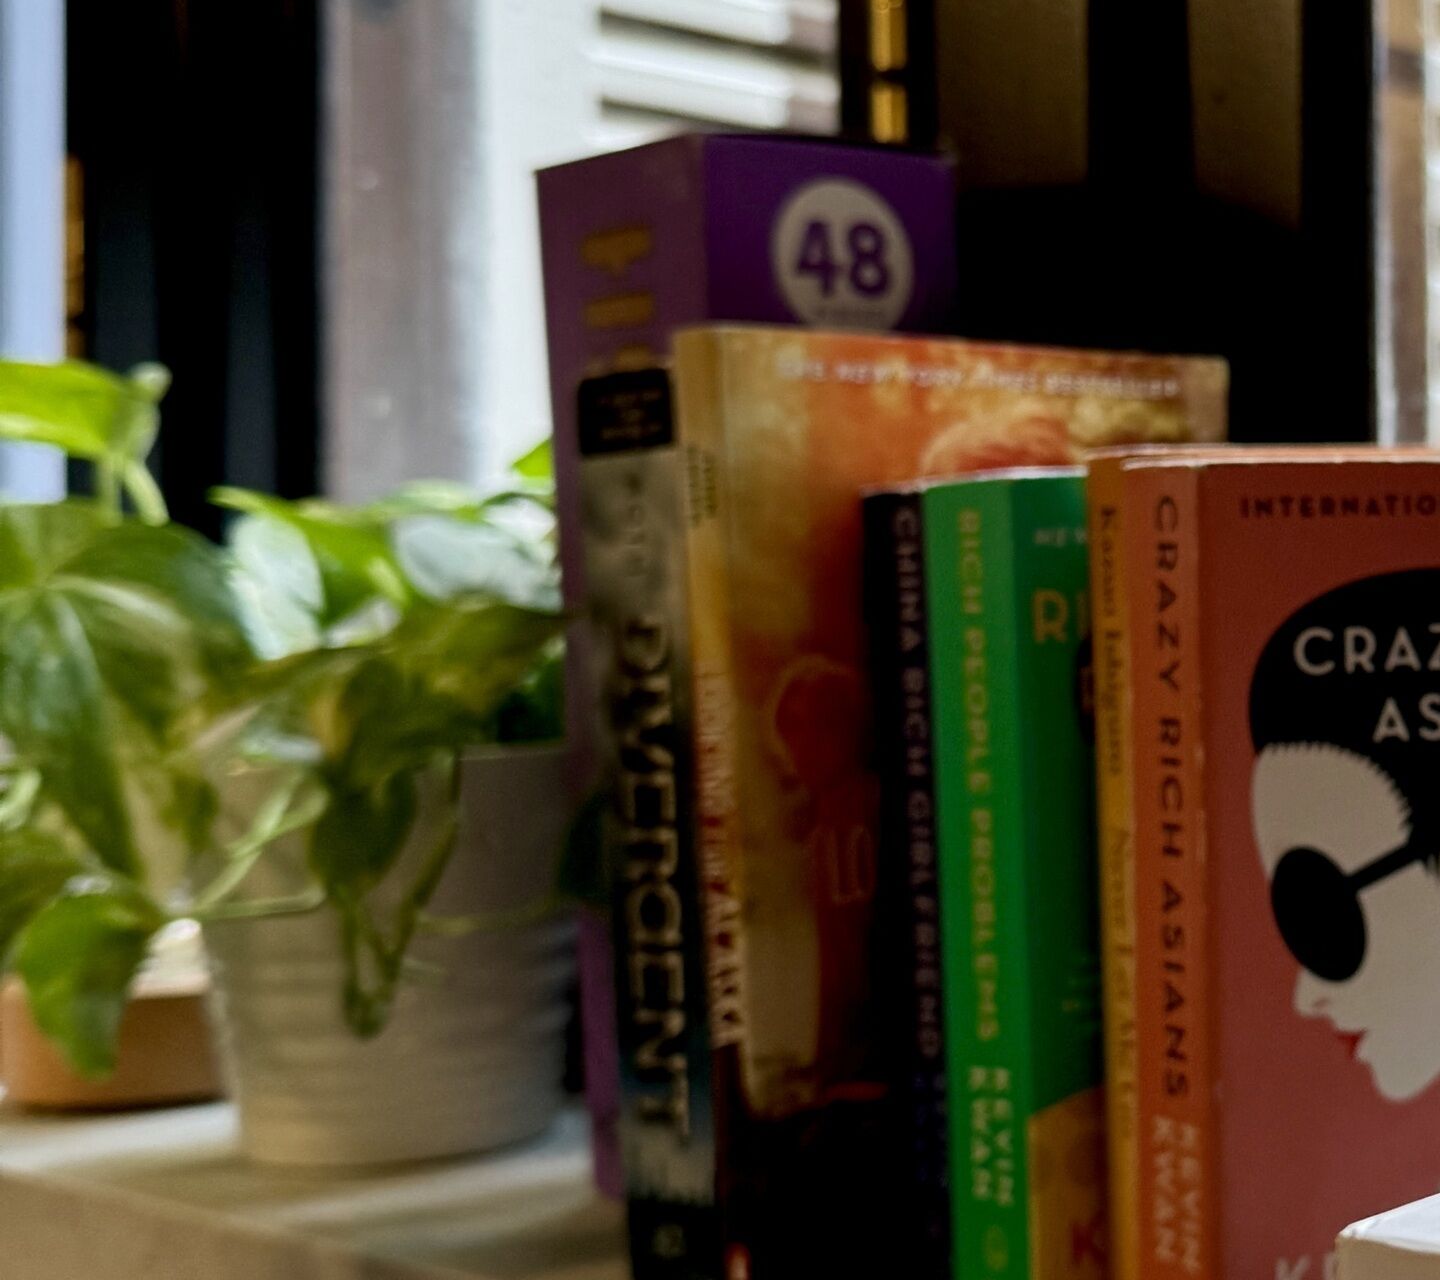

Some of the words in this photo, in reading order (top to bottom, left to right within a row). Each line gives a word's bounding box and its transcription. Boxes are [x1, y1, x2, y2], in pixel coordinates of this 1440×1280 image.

[797, 221, 889, 296] 48
[891, 505, 924, 654] CHINA
[956, 508, 985, 615] RICH
[1155, 495, 1181, 692] CRAZY
[901, 664, 931, 780] RICH
[960, 625, 993, 796] PEOPLE
[1159, 717, 1184, 859] RICH
[617, 617, 689, 1137] DIVERGENT
[905, 785, 941, 1062] GIRLFRIEND
[968, 806, 1000, 1042] PROBLEMS
[1161, 880, 1188, 1098] ASIANS
[991, 1065, 1014, 1209] KEVIN
[1152, 1114, 1177, 1264] KWAN
[1178, 1123, 1201, 1274] KEVIN
